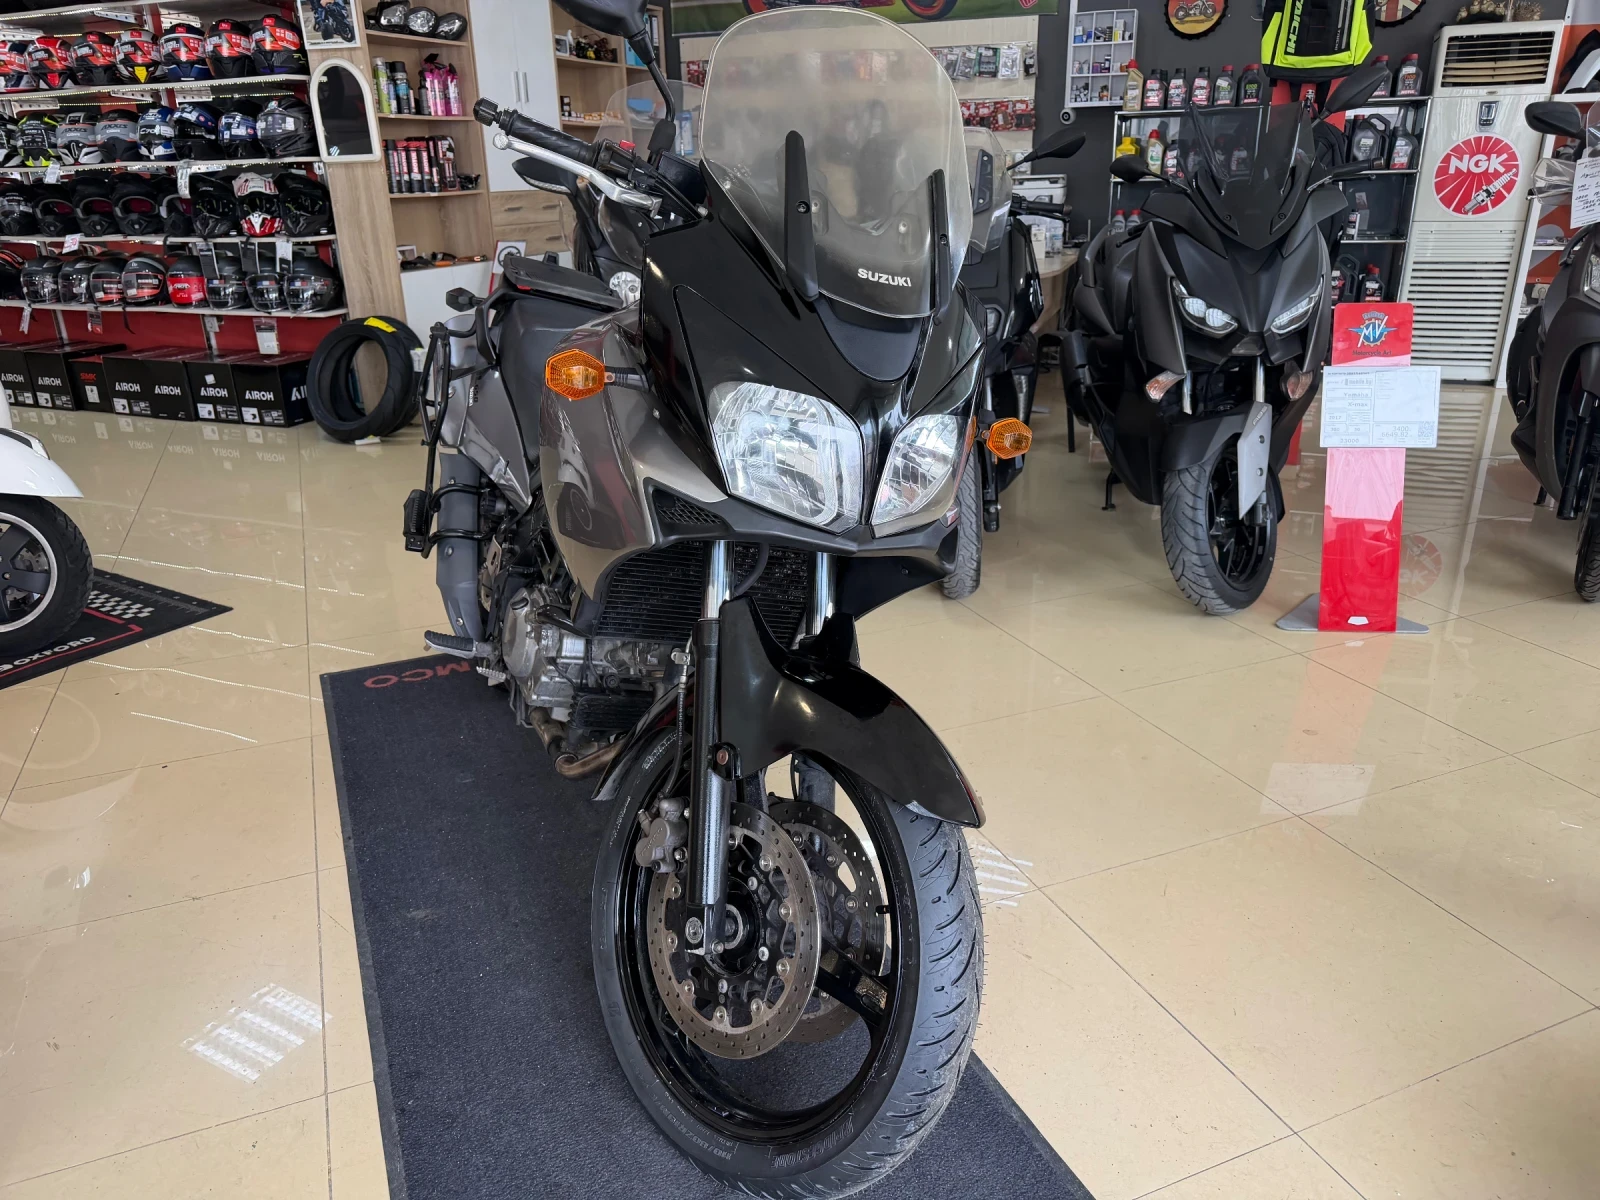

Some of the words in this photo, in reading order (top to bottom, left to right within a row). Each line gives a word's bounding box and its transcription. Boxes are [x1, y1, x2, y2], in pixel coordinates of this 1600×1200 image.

[1448, 153, 1509, 174] NGK
[857, 268, 912, 287] SUZUKI
[1357, 315, 1389, 348] MV
[1, 373, 24, 382] AIROH
[38, 376, 62, 386] AIROH
[115, 382, 141, 392] AIROH
[155, 385, 181, 396] AIROH
[200, 387, 228, 397] AIROH
[245, 390, 274, 401] AIROH
[14, 636, 97, 666] OXFORD
[363, 660, 472, 688] MCO
